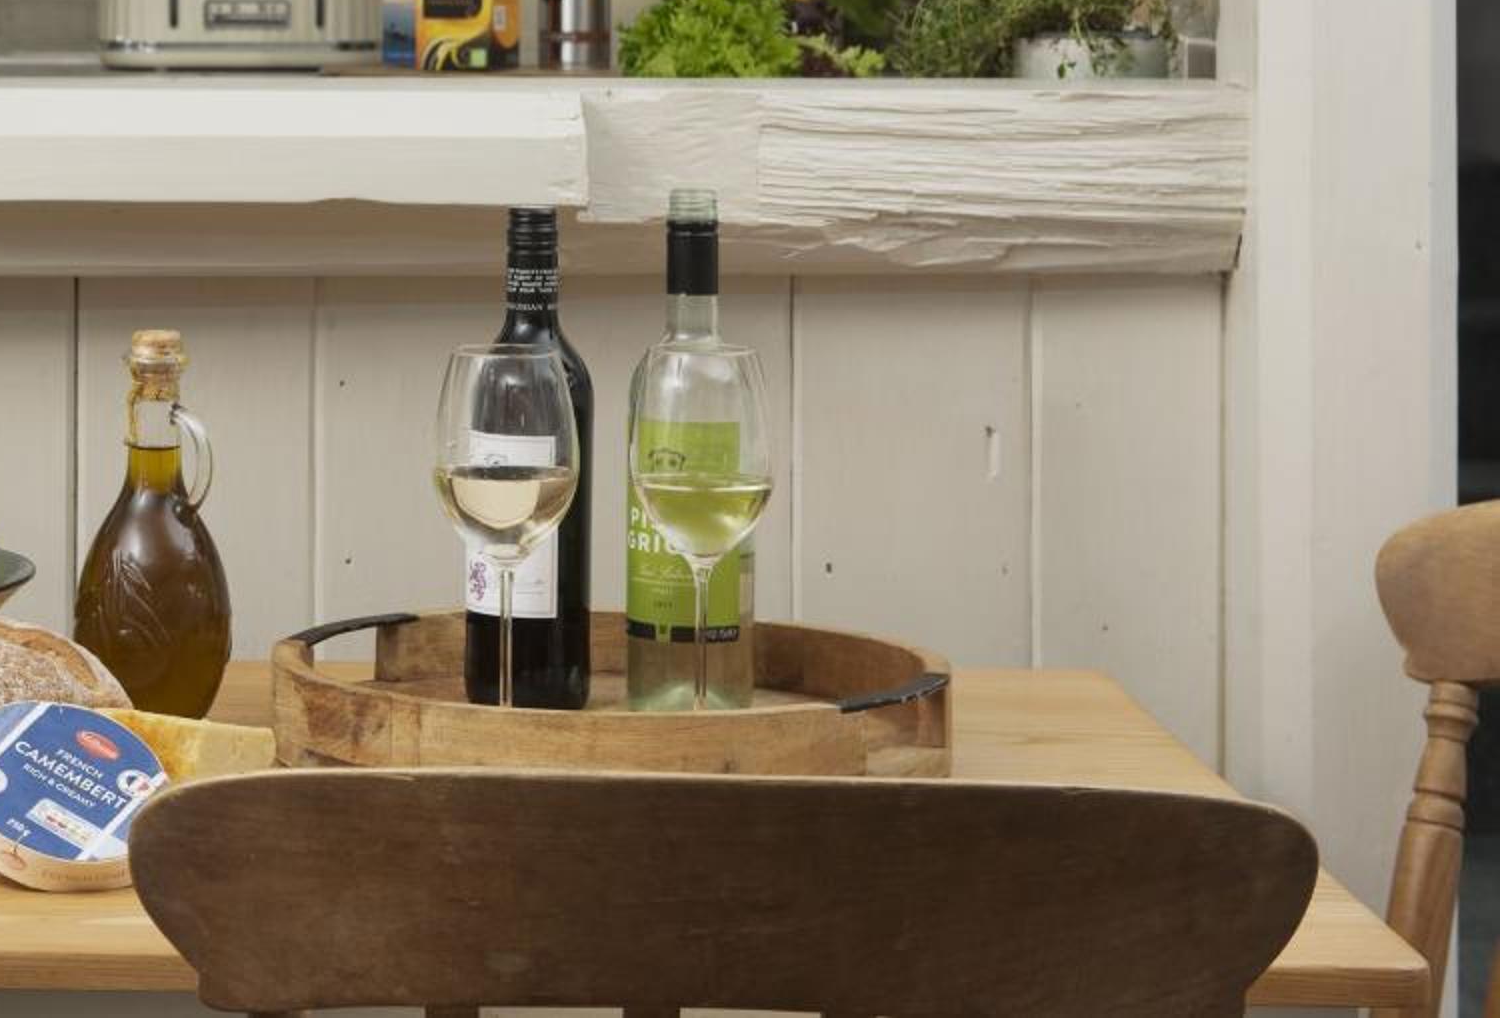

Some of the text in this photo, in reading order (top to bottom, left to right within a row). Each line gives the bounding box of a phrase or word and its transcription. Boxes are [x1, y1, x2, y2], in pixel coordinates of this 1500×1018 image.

[15, 741, 128, 809] CAMEMBERT
[23, 764, 49, 782] RICH
[55, 783, 97, 808] CREAMY
[57, 749, 104, 779] FRENCH
